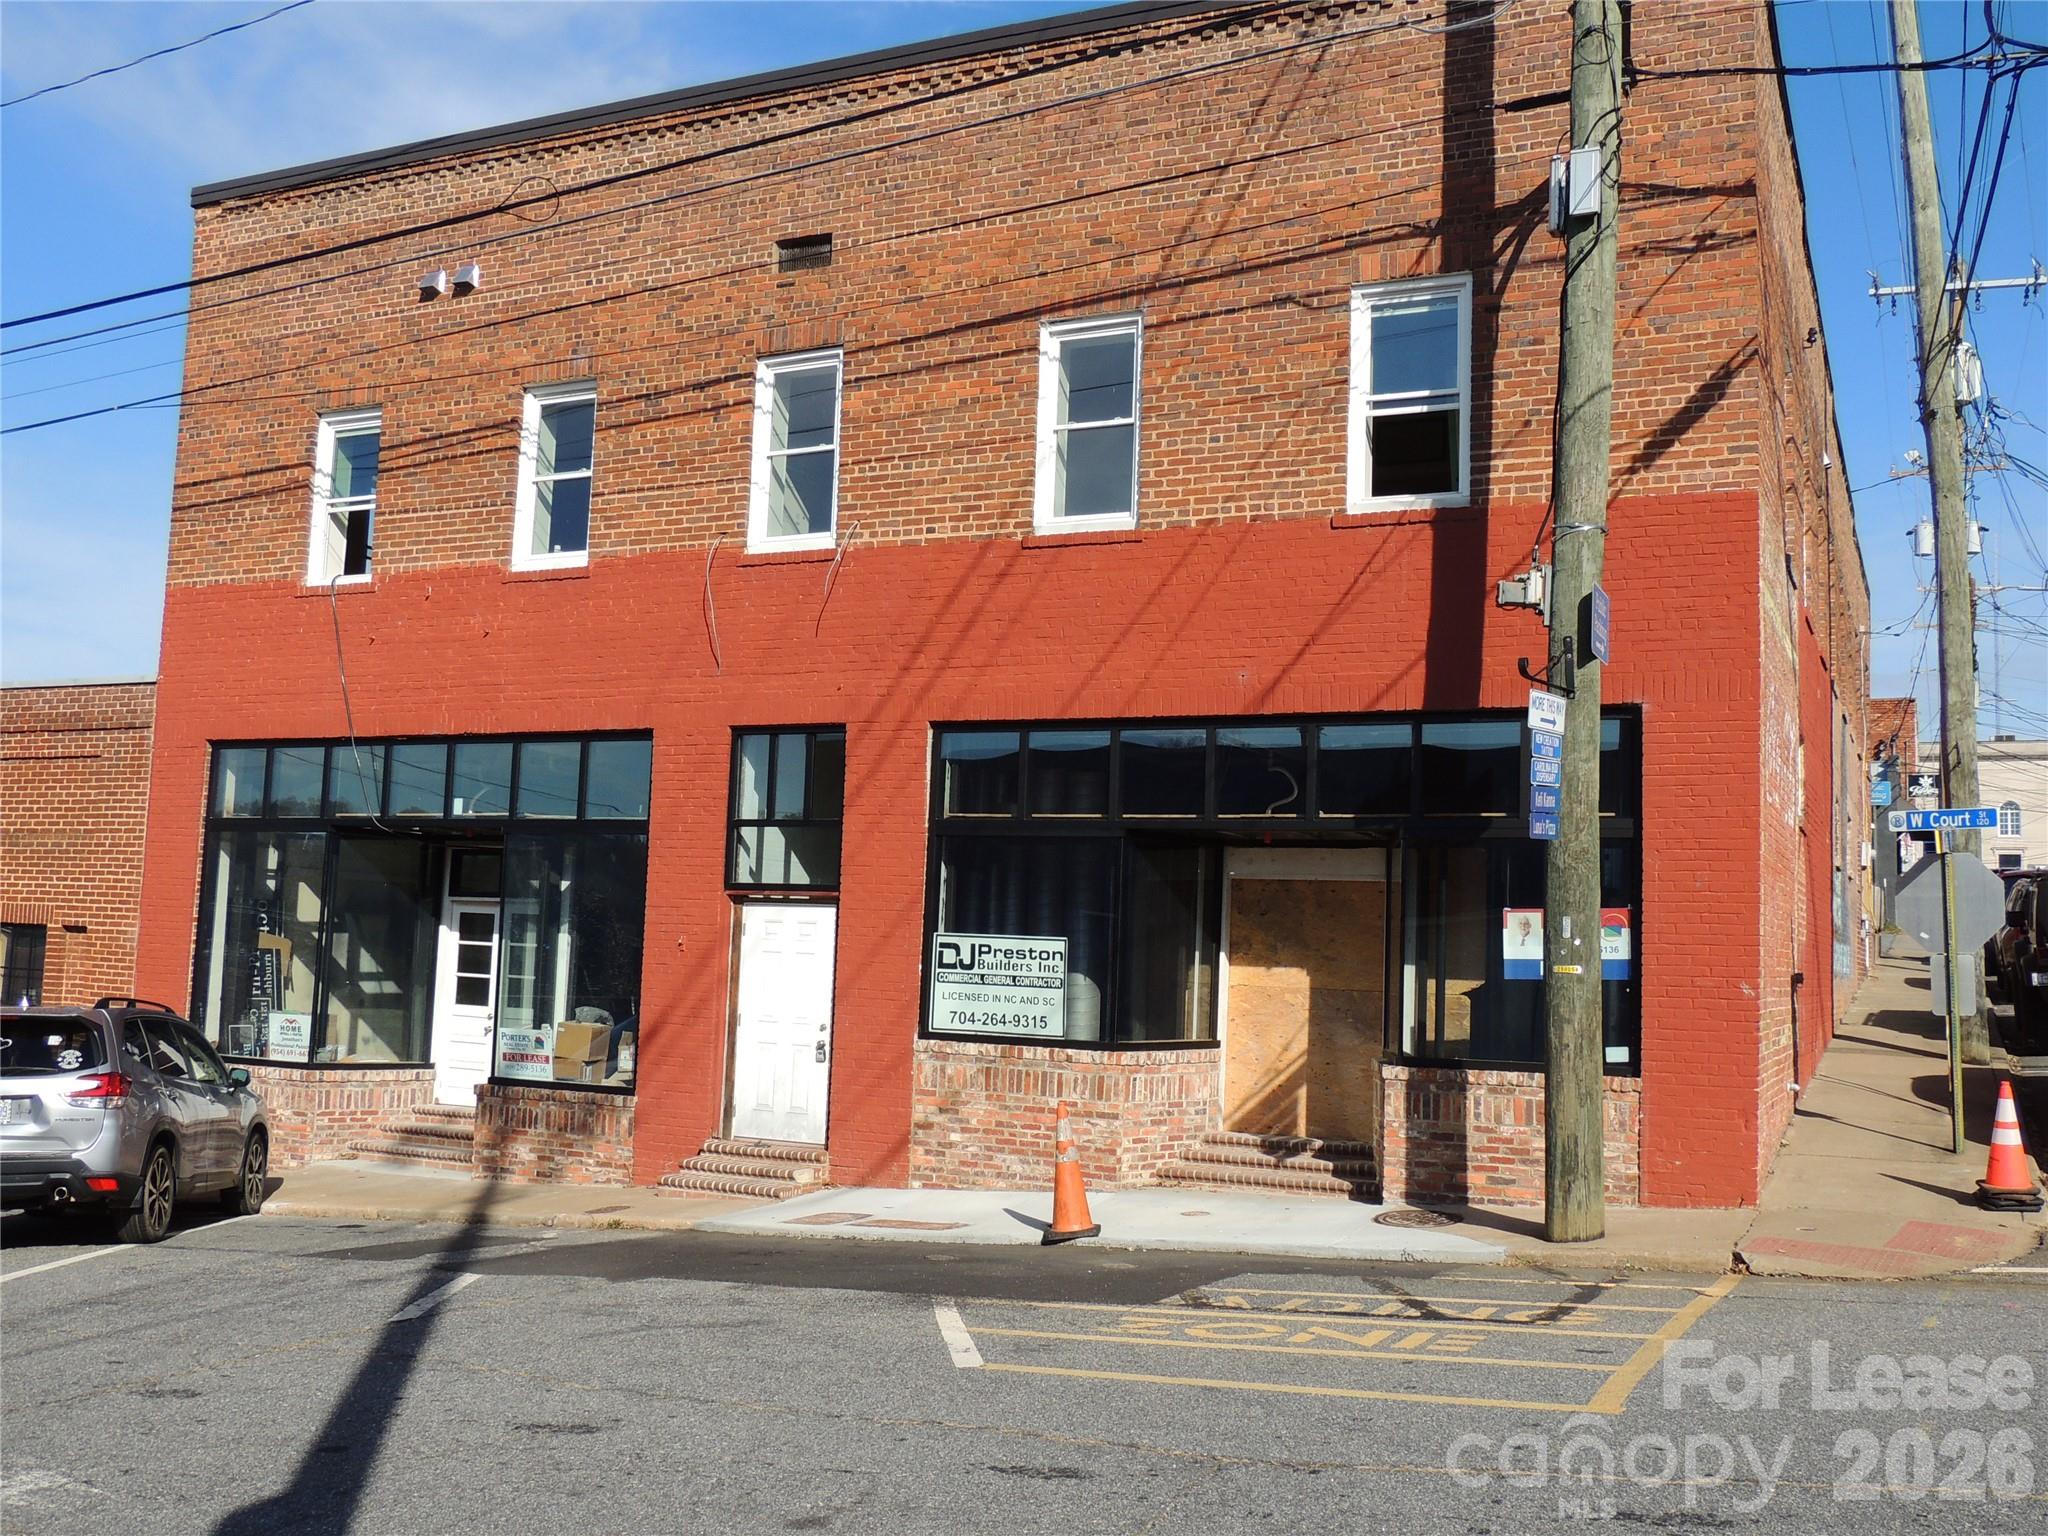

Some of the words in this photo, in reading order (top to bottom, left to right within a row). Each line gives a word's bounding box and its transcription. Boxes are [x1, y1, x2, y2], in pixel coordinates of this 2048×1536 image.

[1910, 813, 1923, 828] W
[1930, 811, 1971, 827] Court
[1978, 810, 1987, 818] St
[1976, 818, 1990, 826] 120
[938, 942, 976, 971] DJ
[978, 943, 1064, 962] Preston
[977, 958, 1033, 973] Builders
[1038, 961, 1064, 974] Inc.
[938, 972, 983, 984] COMMERCIAL
[983, 975, 1015, 986] GENERAL
[1015, 977, 1062, 988] CONTRACTOR
[942, 991, 990, 1003] LICENSED
[992, 994, 1001, 1003] IN
[1003, 995, 1017, 1004] NC
[1020, 996, 1040, 1006] AND
[1042, 997, 1056, 1007] SC
[949, 1011, 1048, 1030] 704-264-9315
[506, 1053, 521, 1061] FOR
[523, 1054, 547, 1063] LEASE
